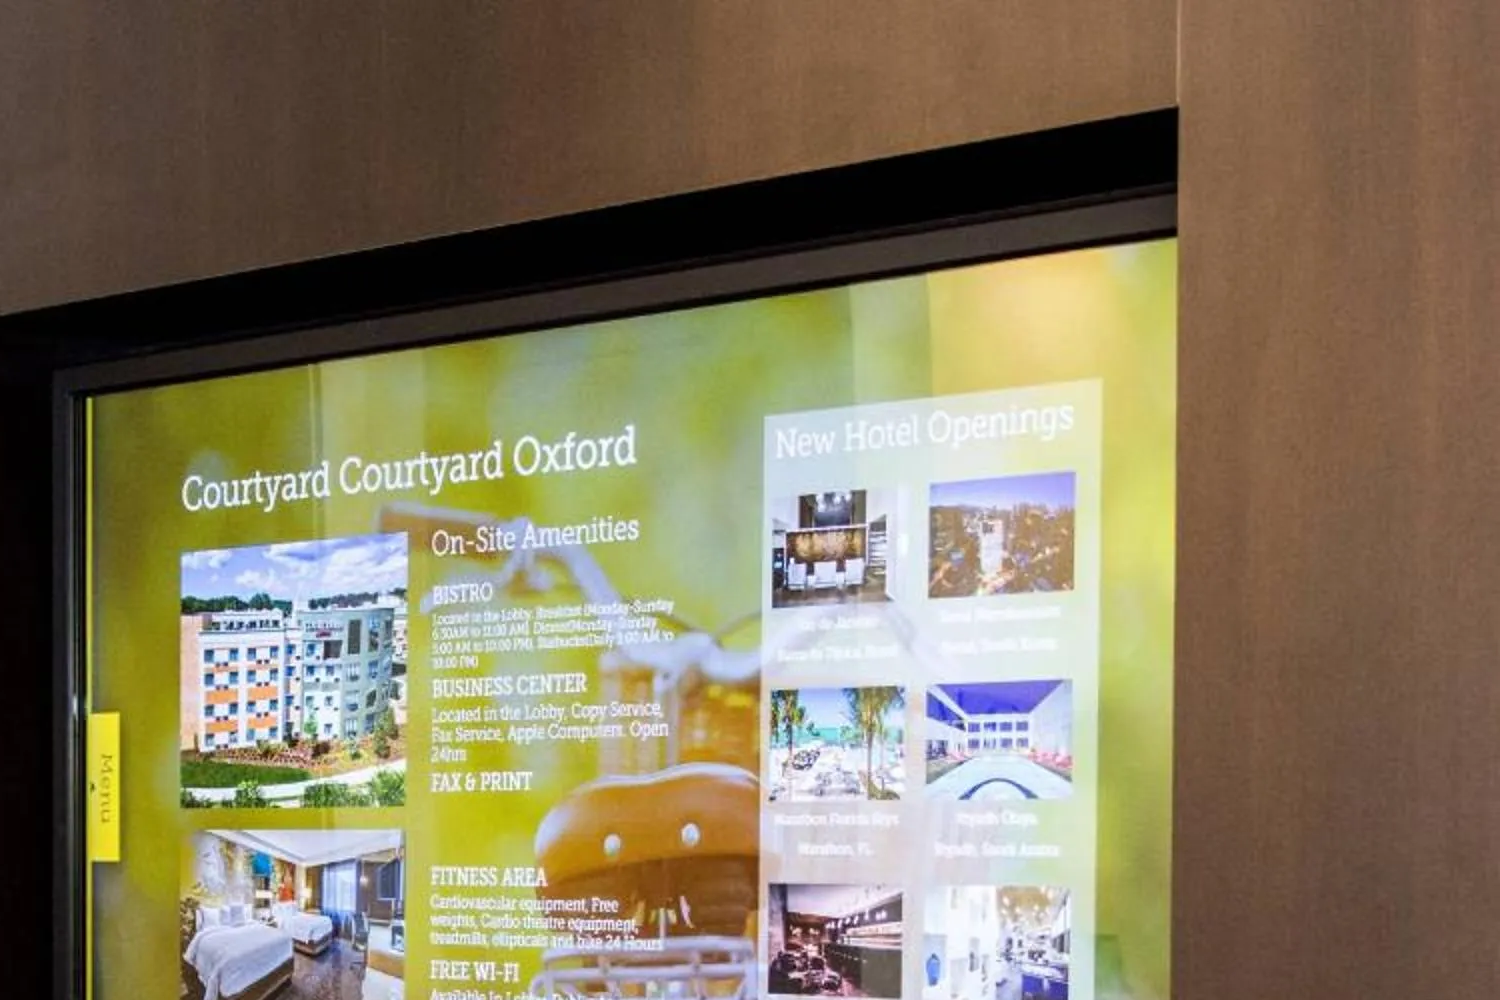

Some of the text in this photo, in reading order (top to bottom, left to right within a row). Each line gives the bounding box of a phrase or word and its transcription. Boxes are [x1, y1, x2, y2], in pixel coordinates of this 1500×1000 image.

[776, 403, 1074, 458] New Hotel Openings
[182, 424, 637, 513] Courtyard Courtyard Oxford
[432, 517, 640, 557] On-Site Amenities
[432, 583, 493, 605] BISTRO
[433, 673, 588, 697] BUSINESS CENTER
[432, 707, 481, 723] Located
[483, 705, 498, 721] in
[499, 703, 520, 720] the
[571, 701, 607, 723] Copy
[507, 723, 546, 745] Apple
[629, 720, 669, 742] Open
[99, 753, 113, 824] Menu
[431, 771, 533, 792] FAX & PRINT
[431, 867, 548, 887] FITNESS AREA
[590, 896, 619, 913] Free
[430, 959, 520, 983] FREE WI-FI
